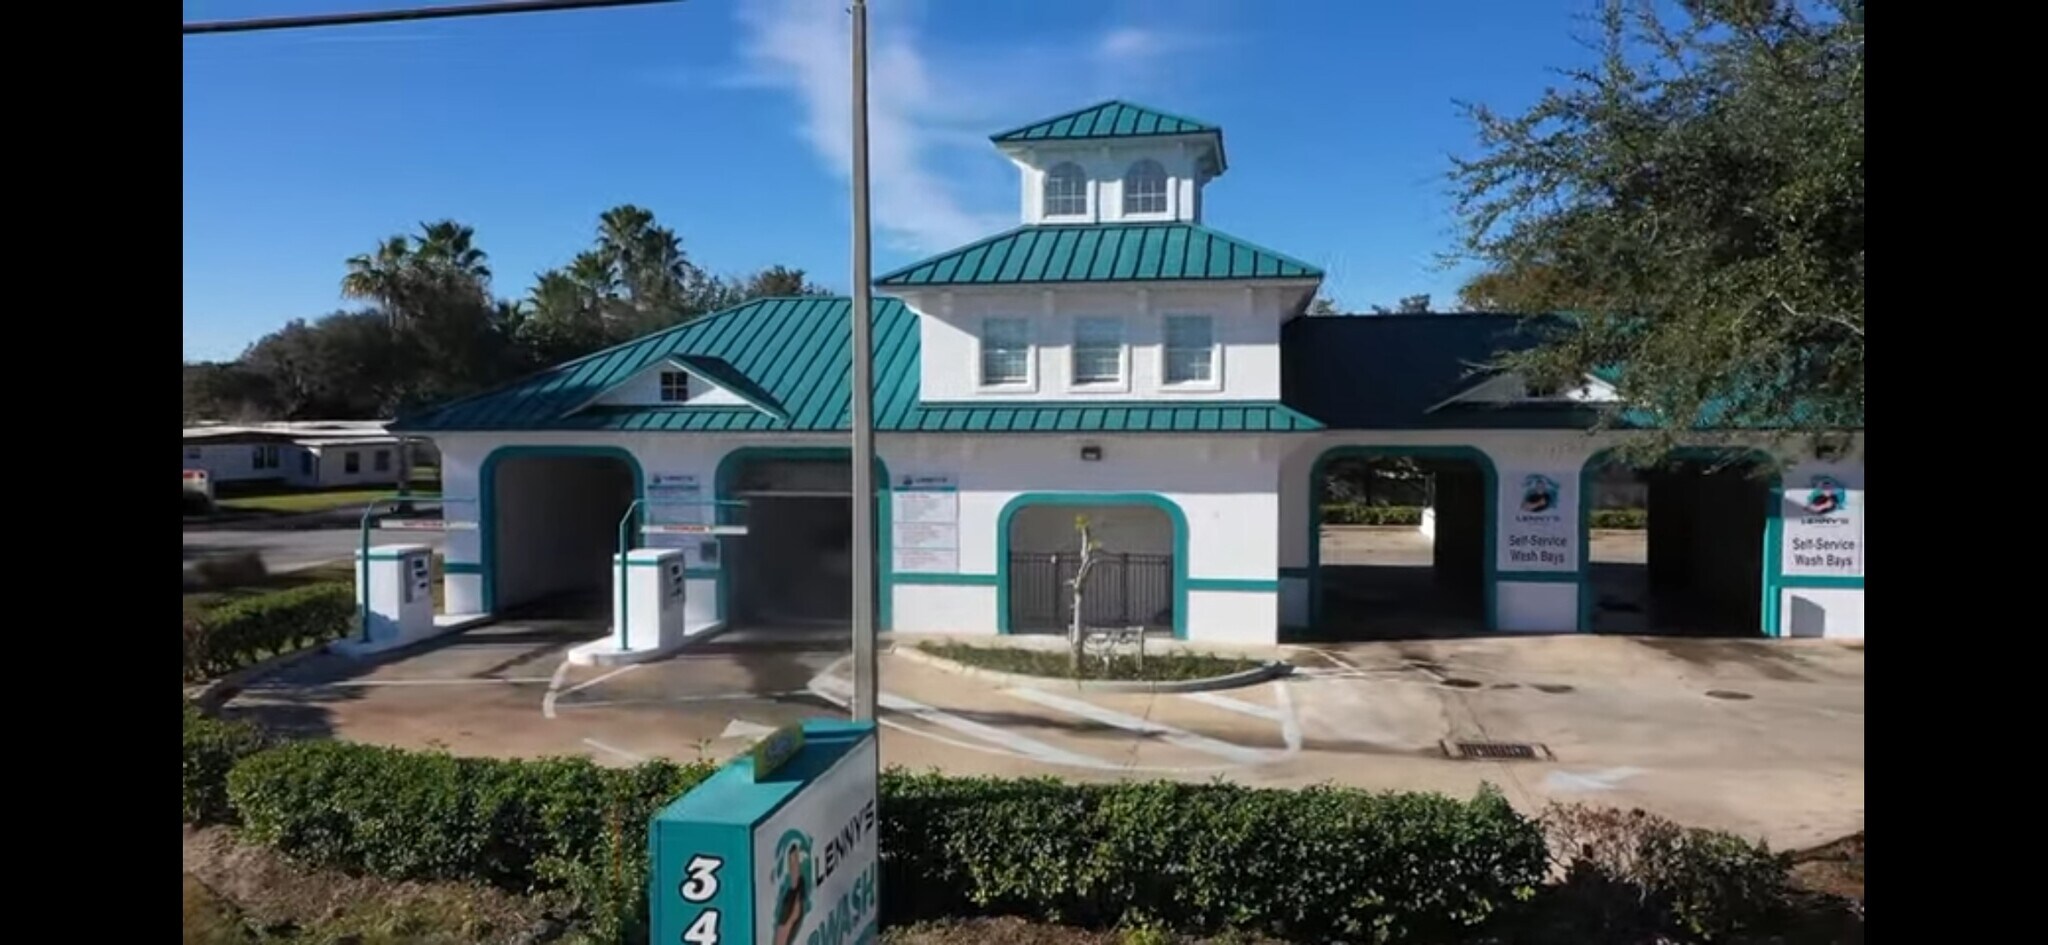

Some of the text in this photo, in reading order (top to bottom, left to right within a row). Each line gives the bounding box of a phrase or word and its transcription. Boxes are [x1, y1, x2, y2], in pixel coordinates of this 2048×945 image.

[1509, 535, 1567, 547] Self-Service
[1792, 537, 1855, 550] Self-Service
[1510, 549, 1565, 565] Wash Bays
[1794, 554, 1852, 568] Wash Bays
[814, 799, 875, 887] LENNY'S
